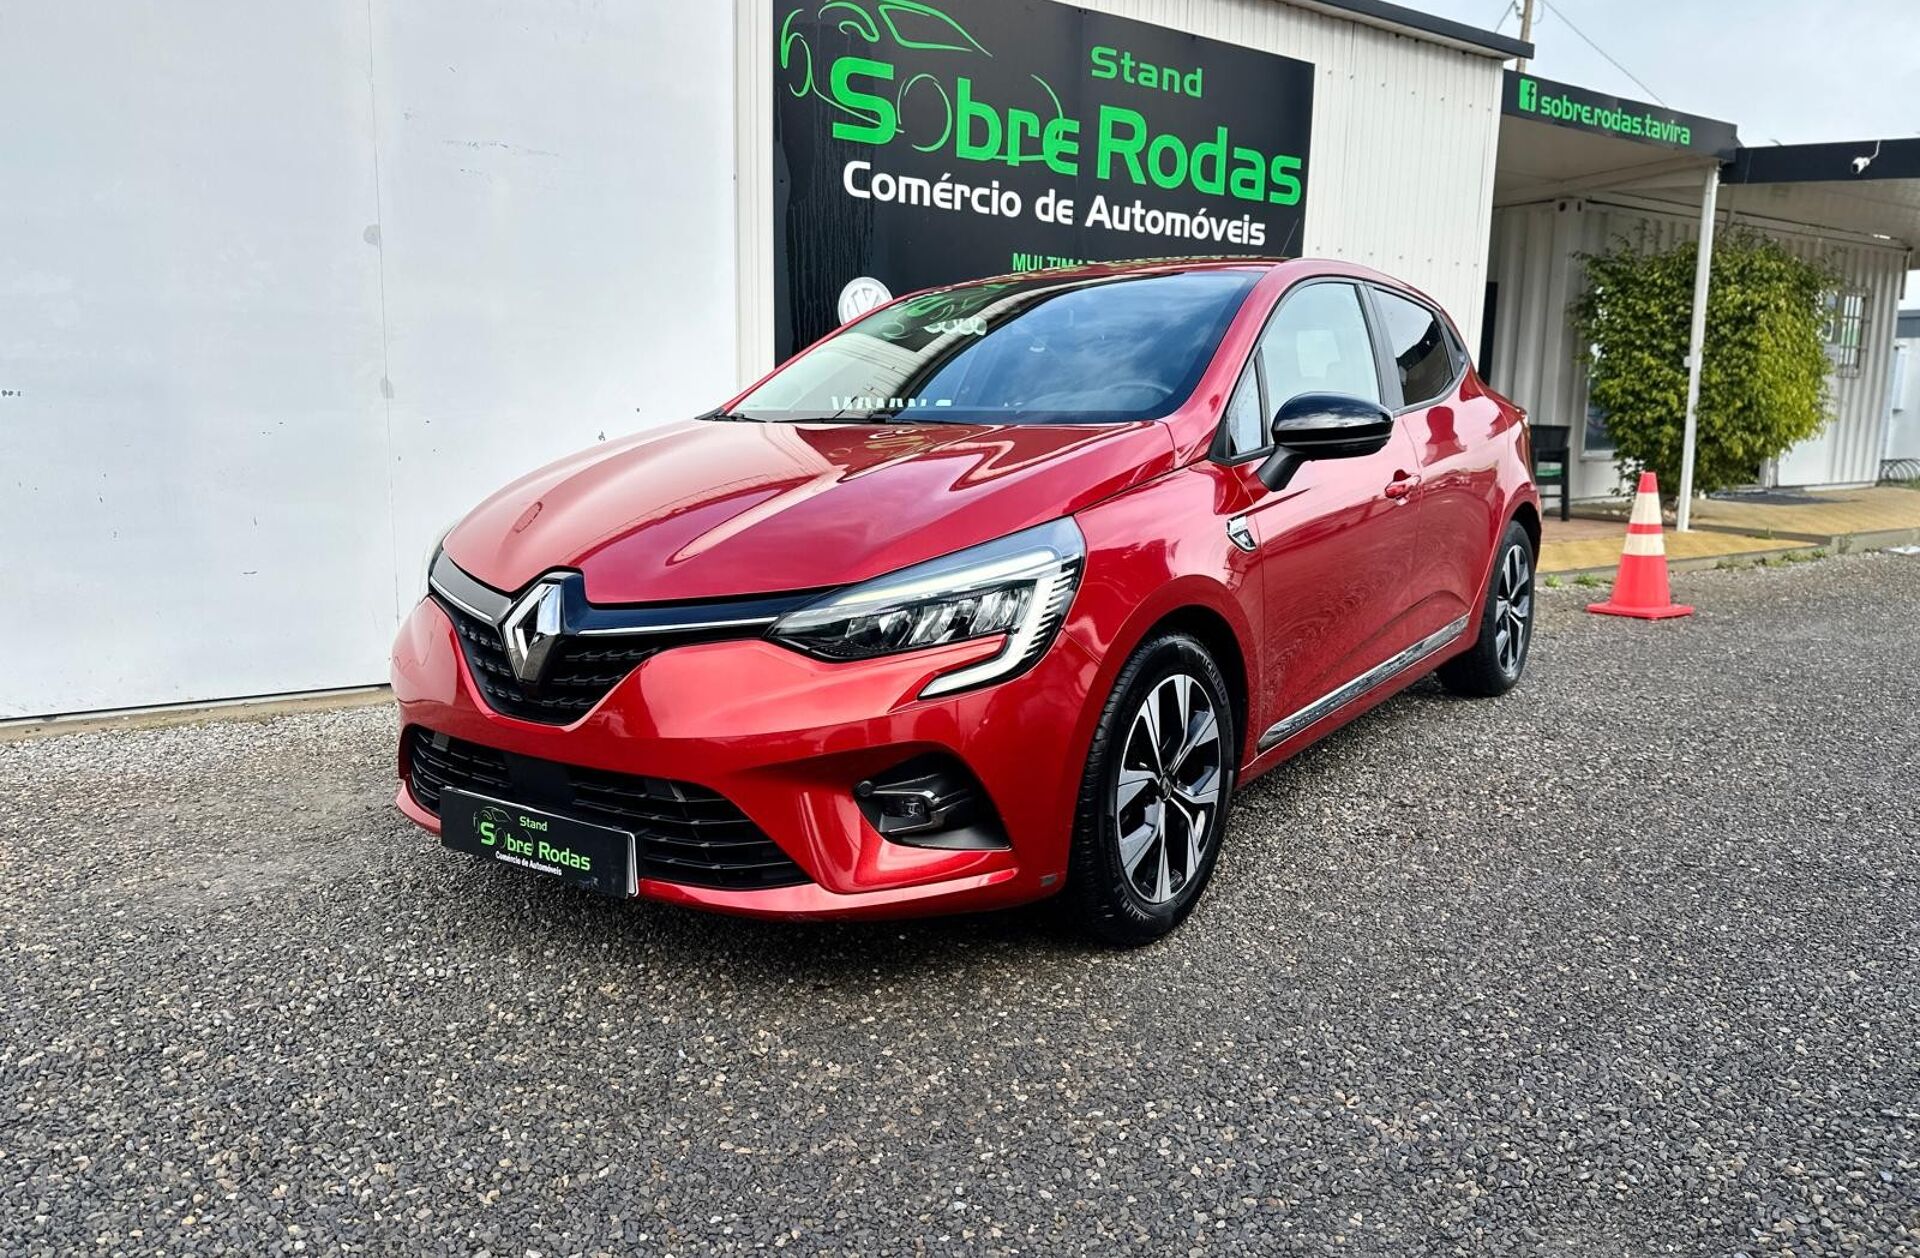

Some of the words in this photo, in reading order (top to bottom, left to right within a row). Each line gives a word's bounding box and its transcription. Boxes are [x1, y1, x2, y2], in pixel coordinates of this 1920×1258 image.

[1091, 46, 1203, 98] Stand
[1540, 95, 1691, 146] sobre.rodas.tavira
[1096, 104, 1302, 206] Rodas
[843, 160, 1022, 218] Comércio
[1034, 188, 1074, 226] de
[1084, 194, 1266, 246] Automóveis
[519, 815, 548, 832] Stand
[538, 840, 591, 871] Rodas
